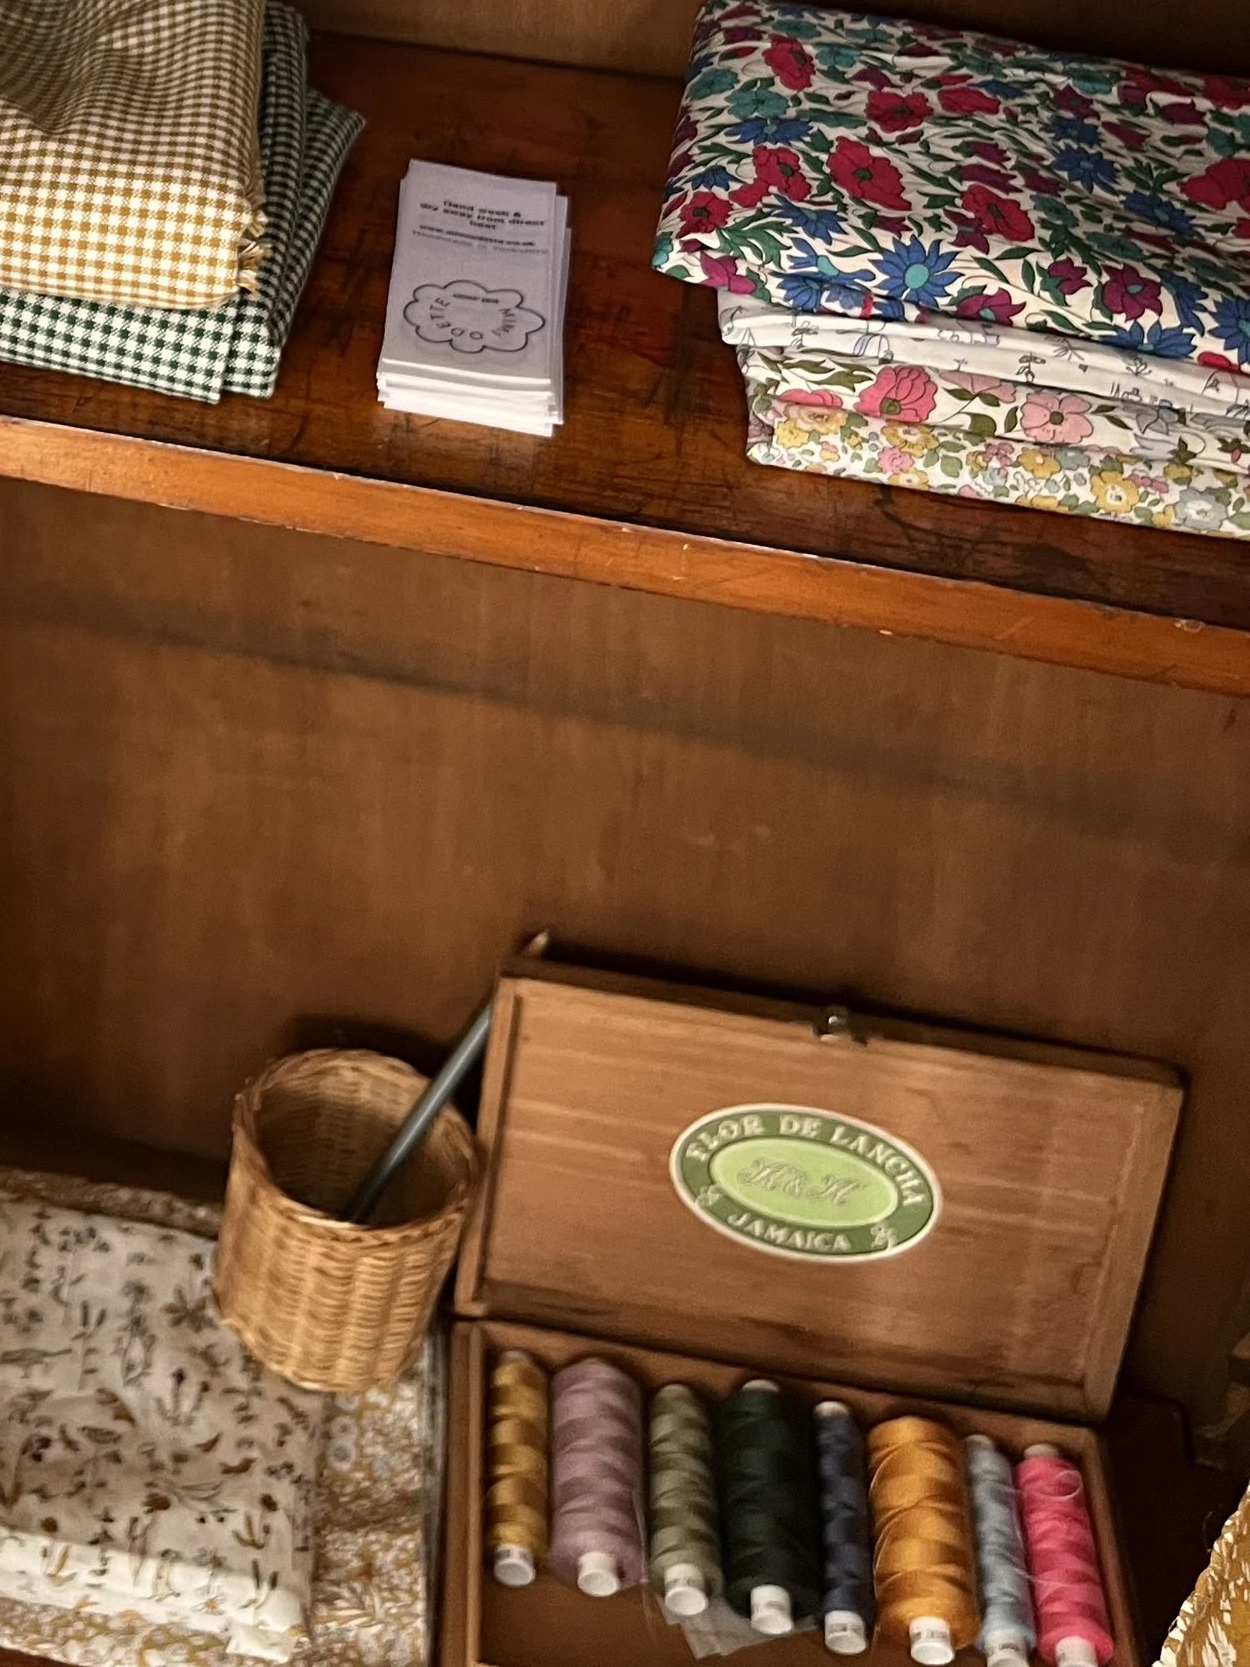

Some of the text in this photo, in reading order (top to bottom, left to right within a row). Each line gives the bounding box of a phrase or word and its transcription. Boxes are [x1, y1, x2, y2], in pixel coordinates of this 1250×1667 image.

[688, 1114, 926, 1206] FLOR DE LANCHA
[729, 1213, 852, 1252] JAMAICA
